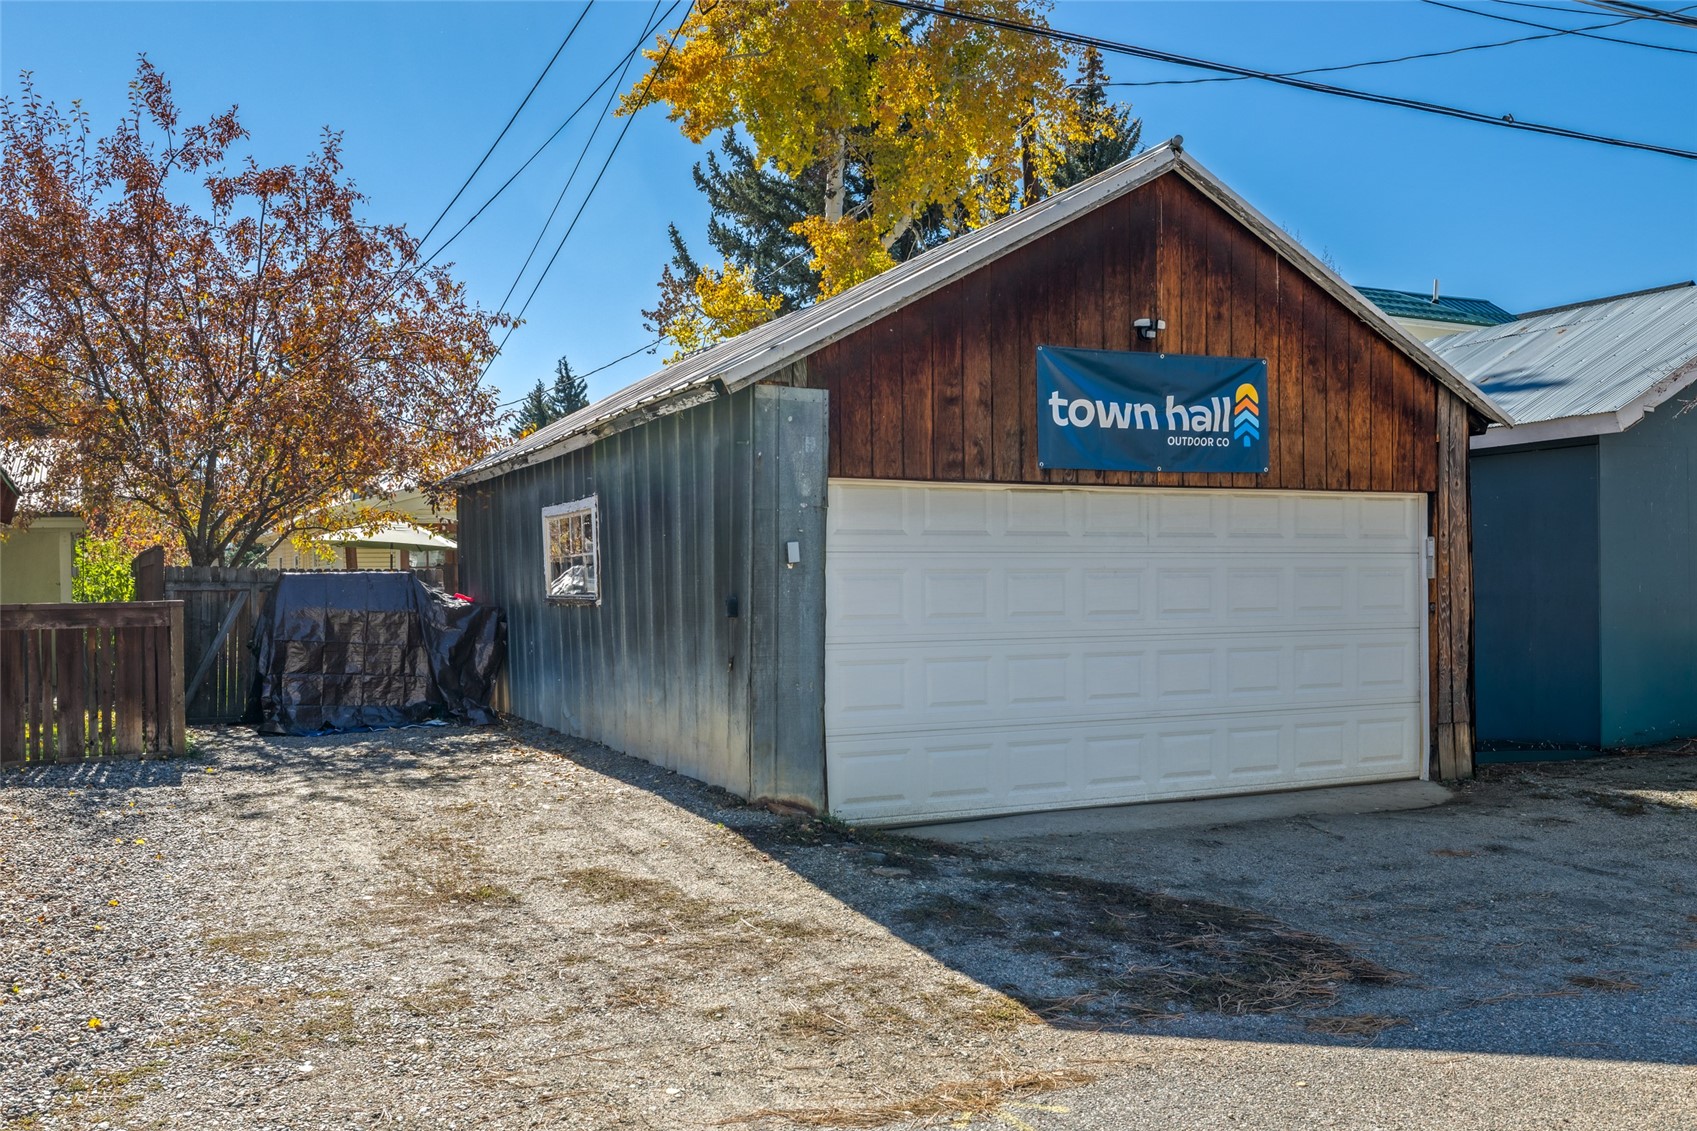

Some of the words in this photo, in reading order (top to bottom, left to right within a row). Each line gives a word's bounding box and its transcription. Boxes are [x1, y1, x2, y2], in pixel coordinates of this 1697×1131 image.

[1049, 390, 1159, 431] town
[1165, 395, 1231, 433] hall
[1167, 436, 1214, 447] OUTDOOR
[1216, 437, 1230, 447] CO
